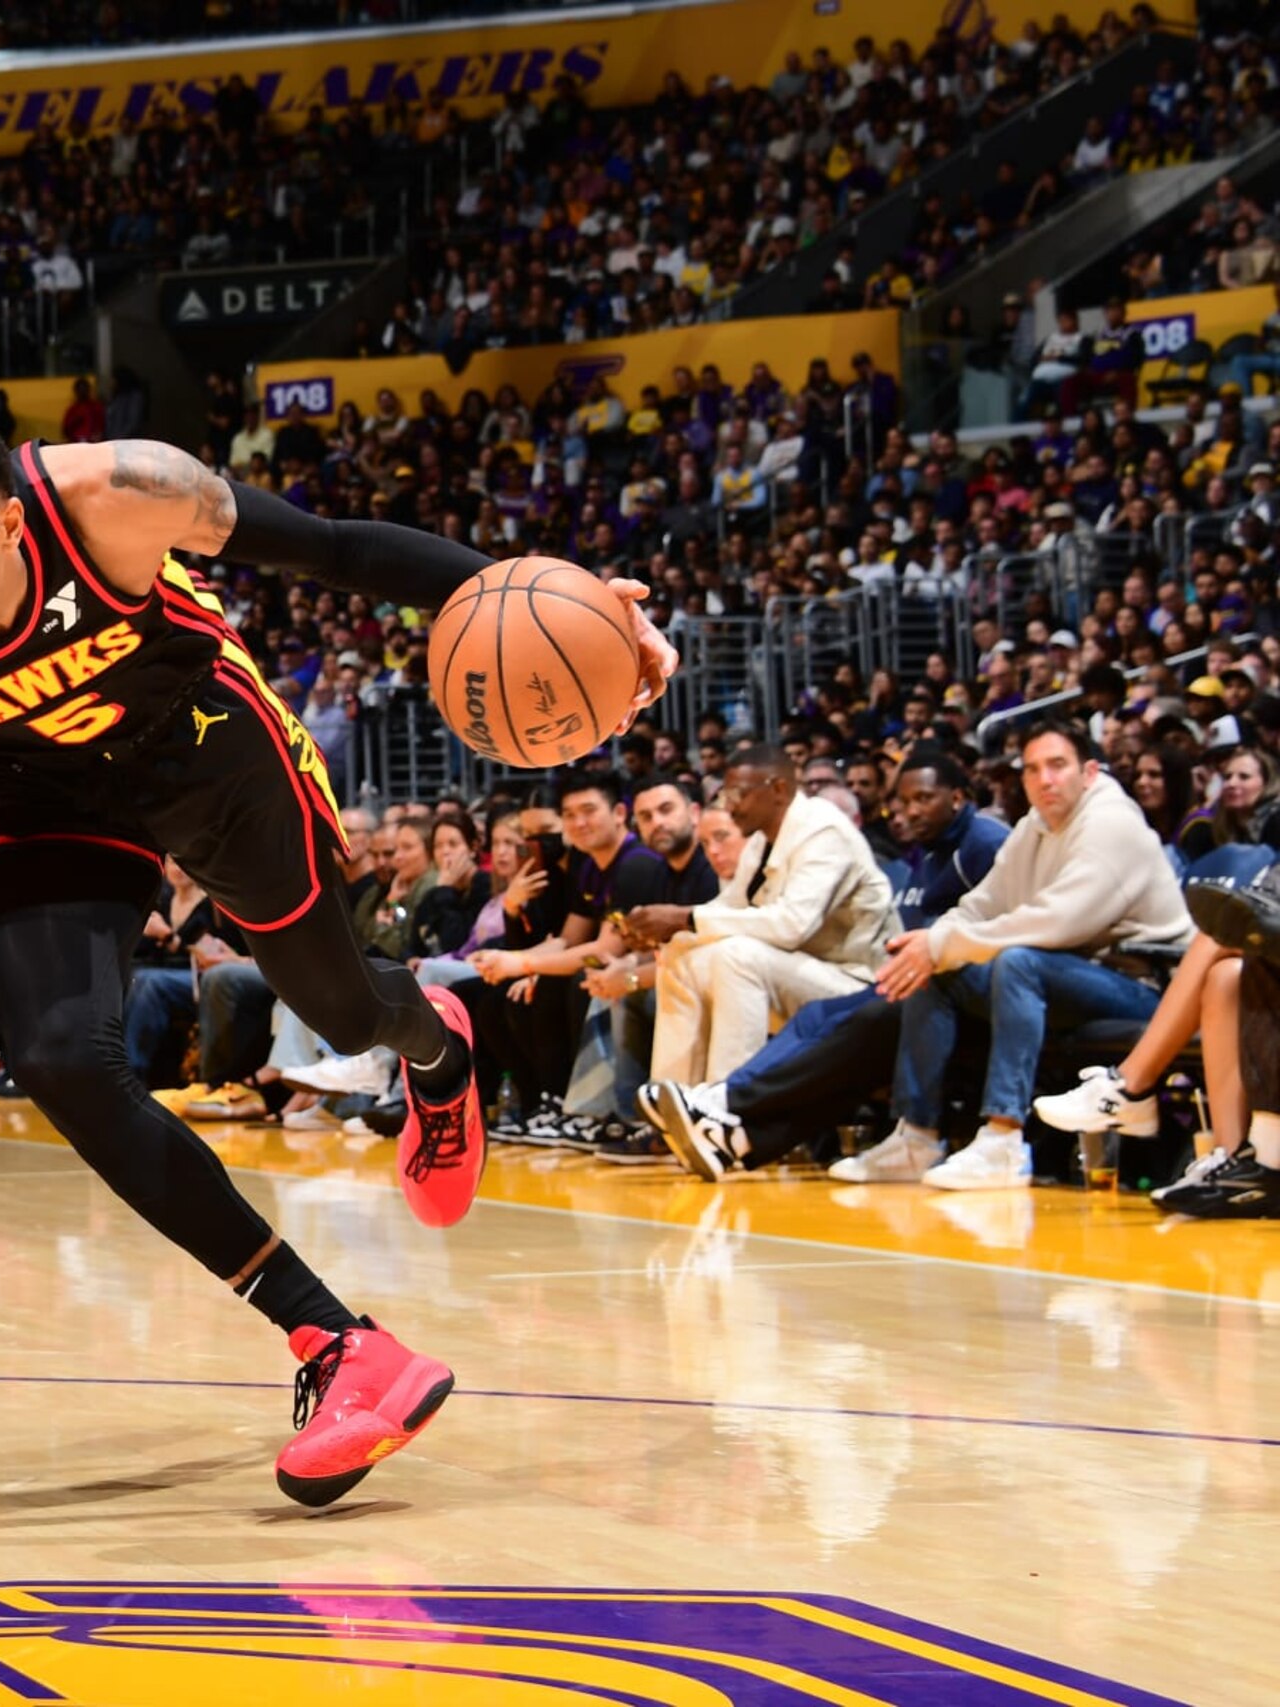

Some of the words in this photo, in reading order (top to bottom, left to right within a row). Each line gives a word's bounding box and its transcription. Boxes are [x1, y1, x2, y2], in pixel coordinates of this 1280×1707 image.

[253, 41, 609, 113] LAKERS
[1142, 319, 1189, 356] 08
[271, 382, 328, 415] 108
[24, 691, 127, 745] 5
